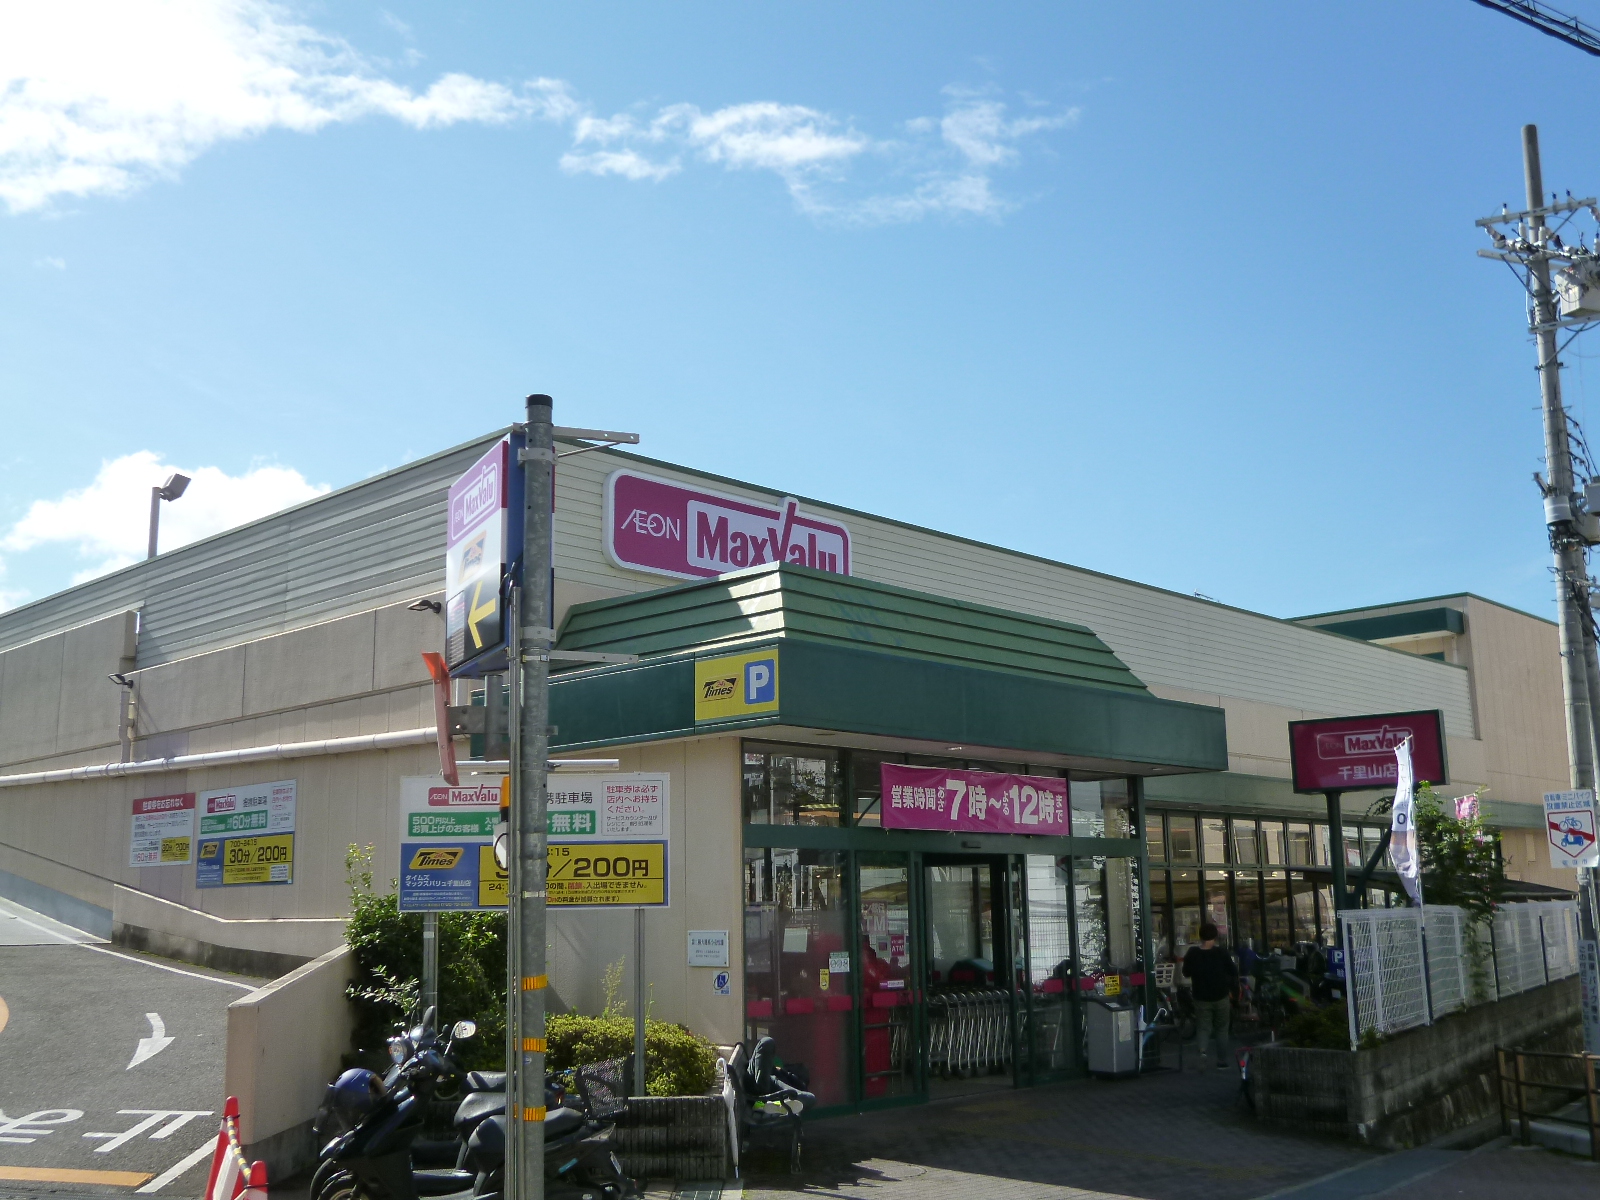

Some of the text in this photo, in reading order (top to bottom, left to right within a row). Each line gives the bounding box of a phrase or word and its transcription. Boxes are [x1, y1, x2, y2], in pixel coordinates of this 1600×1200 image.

[465, 466, 494, 518] MaxValu
[696, 502, 837, 574] MaxValu
[703, 682, 734, 699] Times
[749, 665, 769, 700] P
[1338, 763, 1397, 781] 千里山店
[451, 784, 498, 803] MaxValu
[606, 785, 659, 794] 駐車券は必ず
[606, 795, 658, 804] 店内へお持ち
[412, 816, 456, 825] 500円以上
[412, 824, 479, 834] お買上げのお客様
[418, 853, 455, 867] Times
